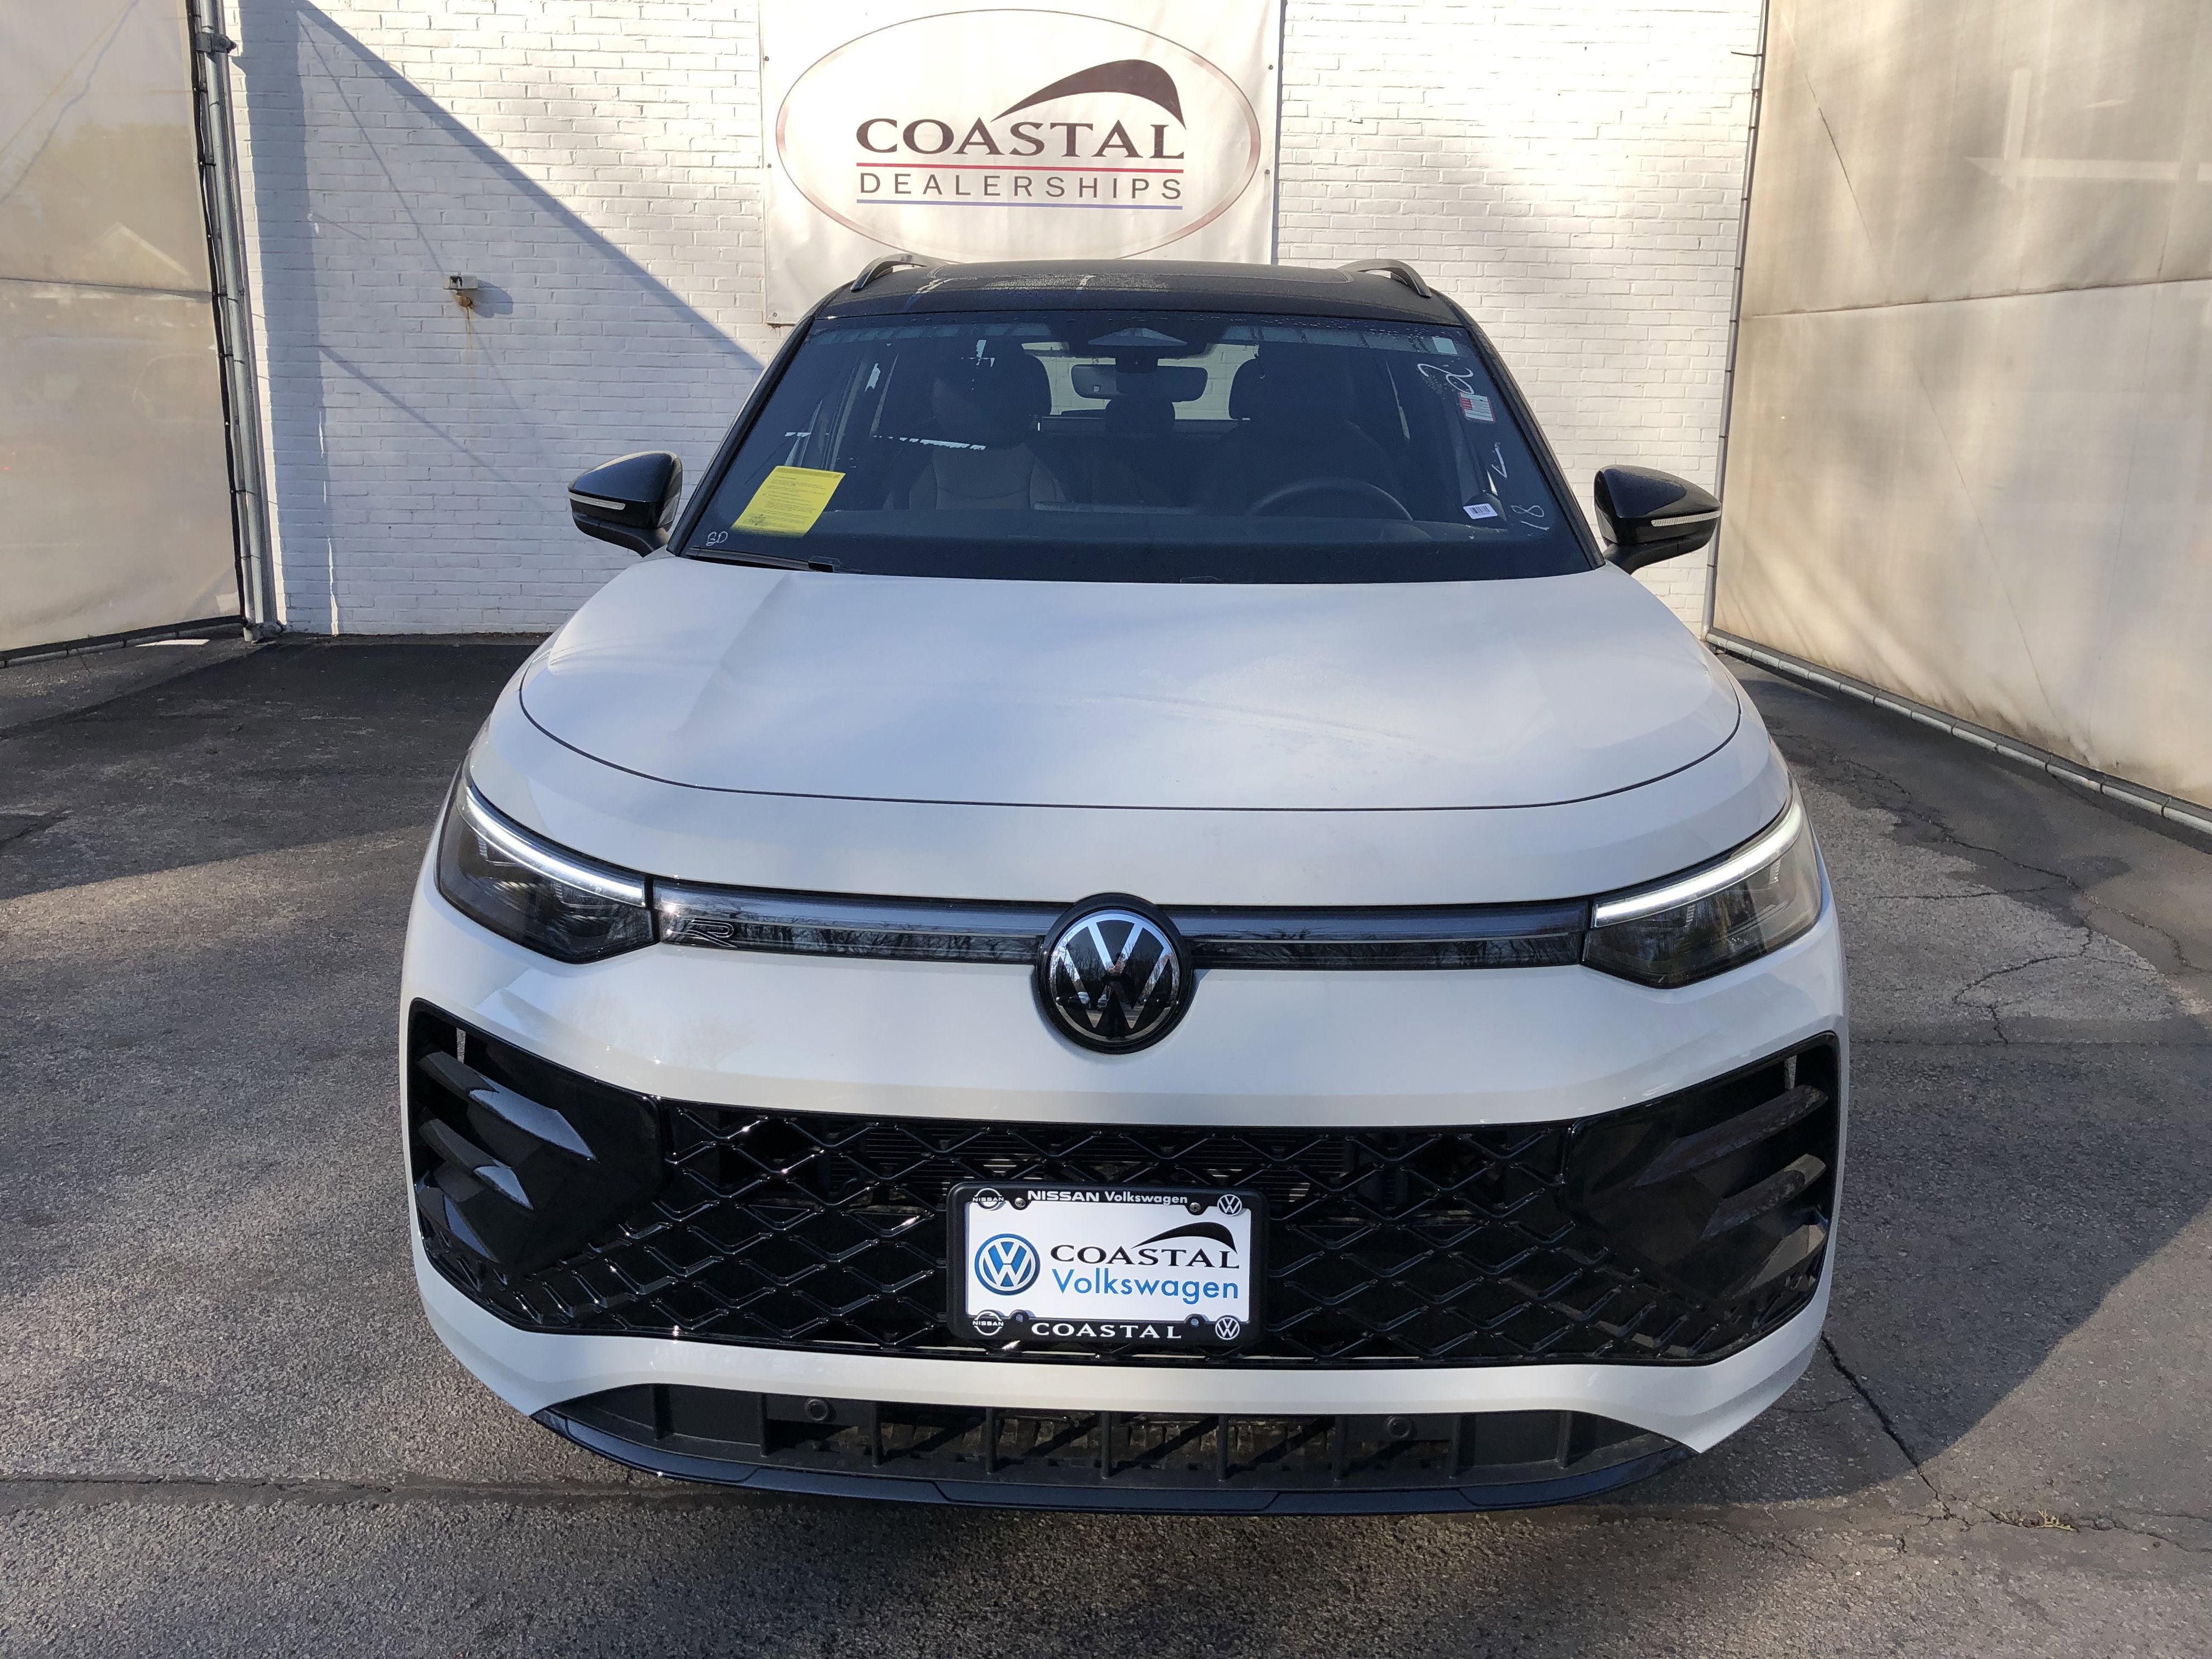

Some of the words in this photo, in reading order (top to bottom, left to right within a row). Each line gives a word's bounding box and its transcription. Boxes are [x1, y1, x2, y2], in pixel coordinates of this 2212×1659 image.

[856, 117, 1184, 159] COASTAL
[860, 173, 1182, 200] DEALERSHIPS
[1028, 1190, 1099, 1201] NISSAN
[1105, 1191, 1188, 1205] Volkswagen
[1050, 1245, 1239, 1268] COASTAL
[1052, 1268, 1238, 1304] Volkswagen
[1031, 1323, 1181, 1339] COASTAL
